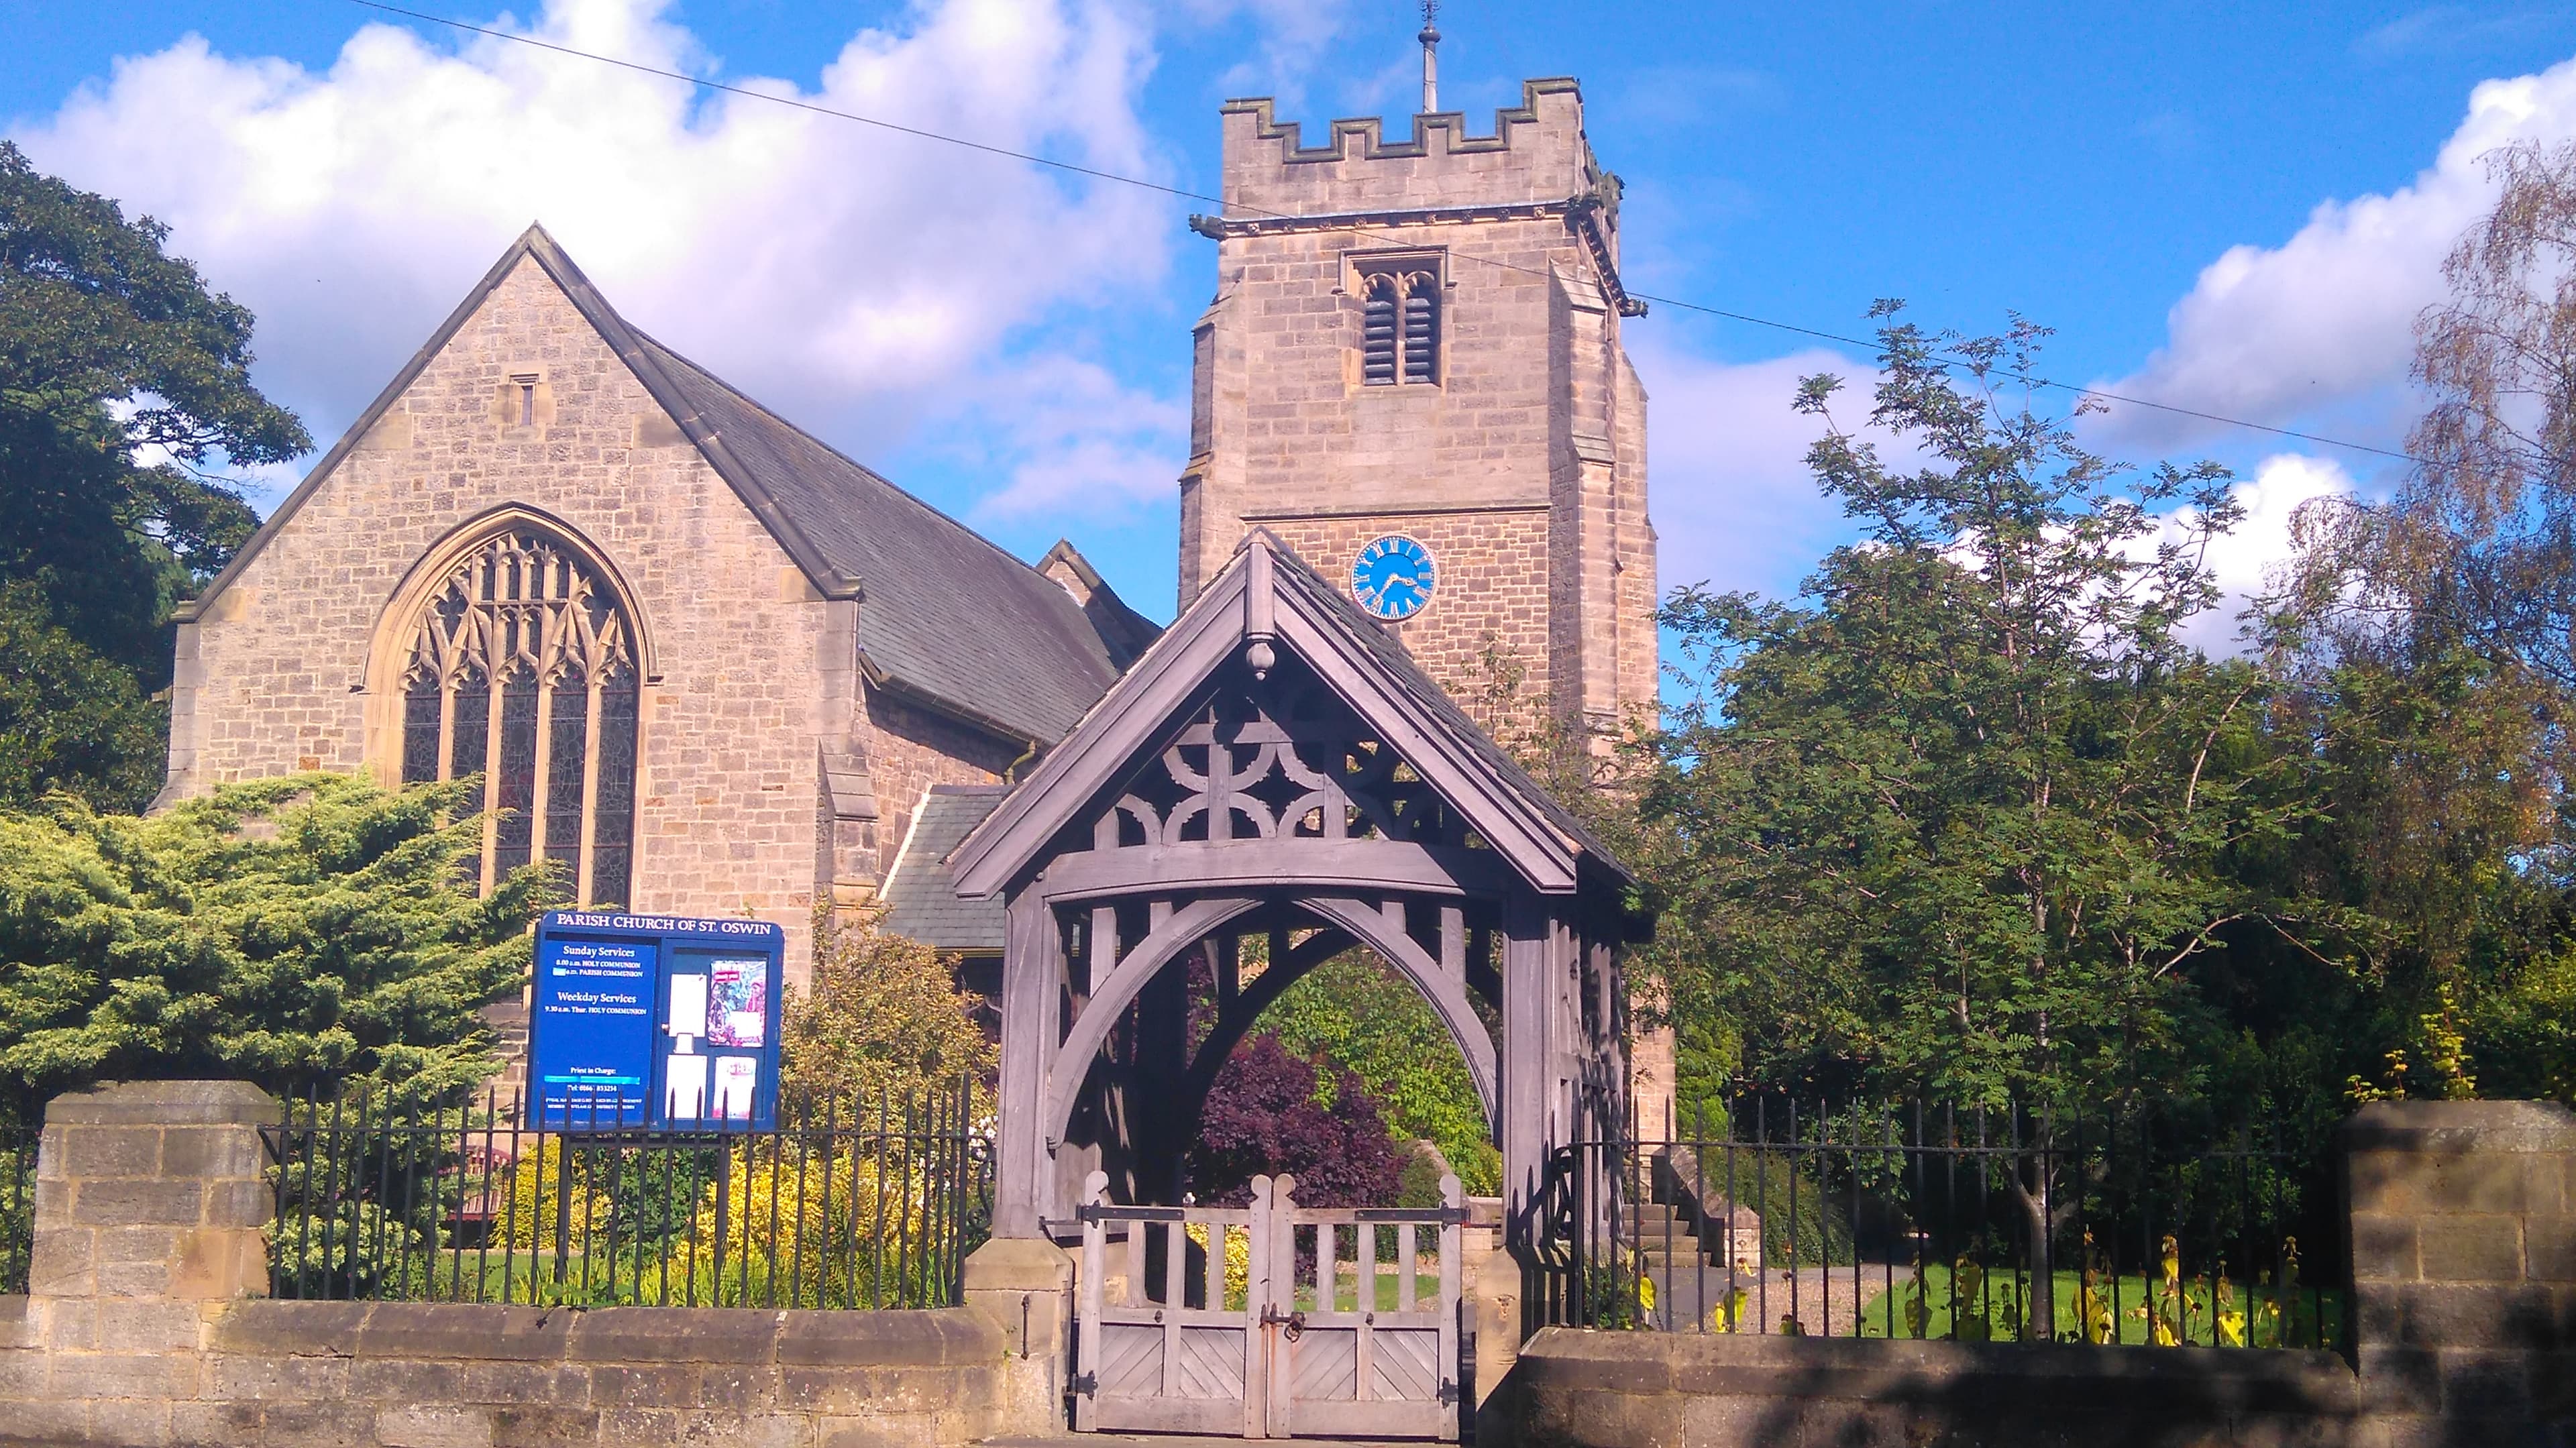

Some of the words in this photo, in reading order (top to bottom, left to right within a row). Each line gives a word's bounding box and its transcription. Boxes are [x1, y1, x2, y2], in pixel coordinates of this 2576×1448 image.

[557, 913, 610, 927] PARISH
[613, 916, 674, 930] CHURCH
[678, 920, 696, 931] OF
[698, 921, 718, 932] ST.
[721, 922, 771, 935] OSWIN
[564, 946, 597, 958] Sunday
[598, 947, 635, 957] Services
[557, 991, 599, 1005] Weekday
[600, 993, 637, 1003] Services
[606, 1007, 647, 1015] COMMUNION
